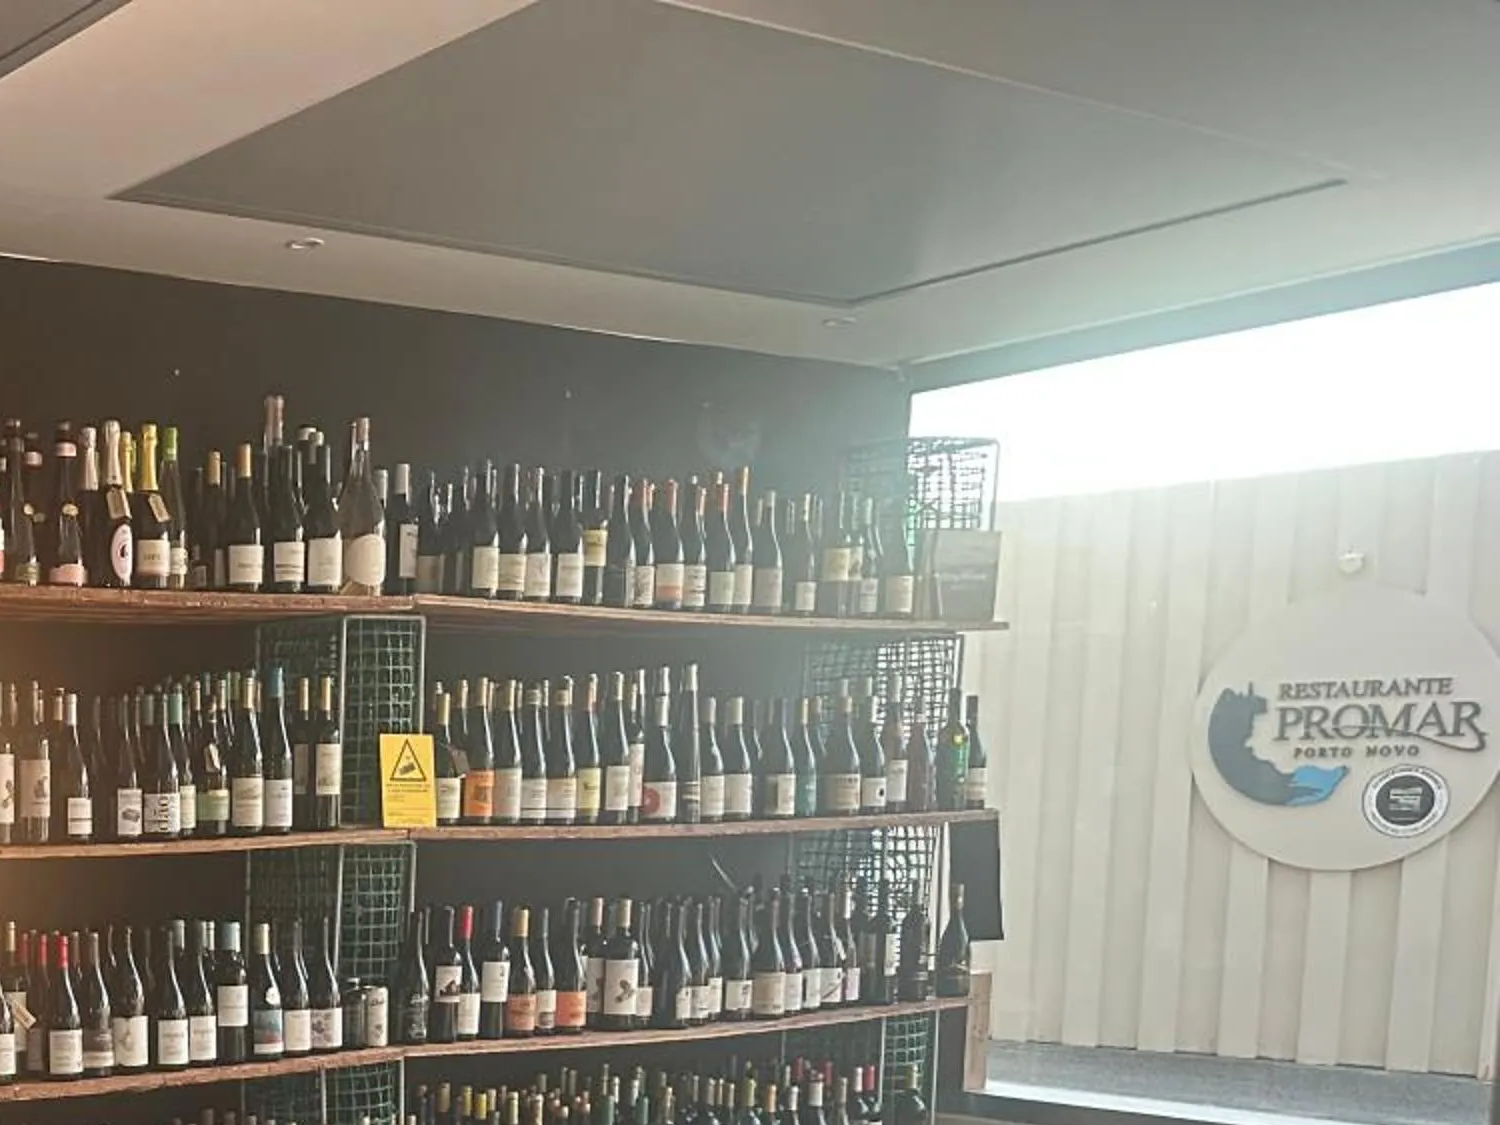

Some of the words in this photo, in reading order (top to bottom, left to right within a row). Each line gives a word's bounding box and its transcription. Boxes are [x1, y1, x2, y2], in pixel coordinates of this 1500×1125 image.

[1278, 677, 1454, 700] RESTAURANTE
[1273, 701, 1489, 751] PROMAR
[1293, 745, 1354, 759] PORTO
[1365, 744, 1421, 758] NOVO
